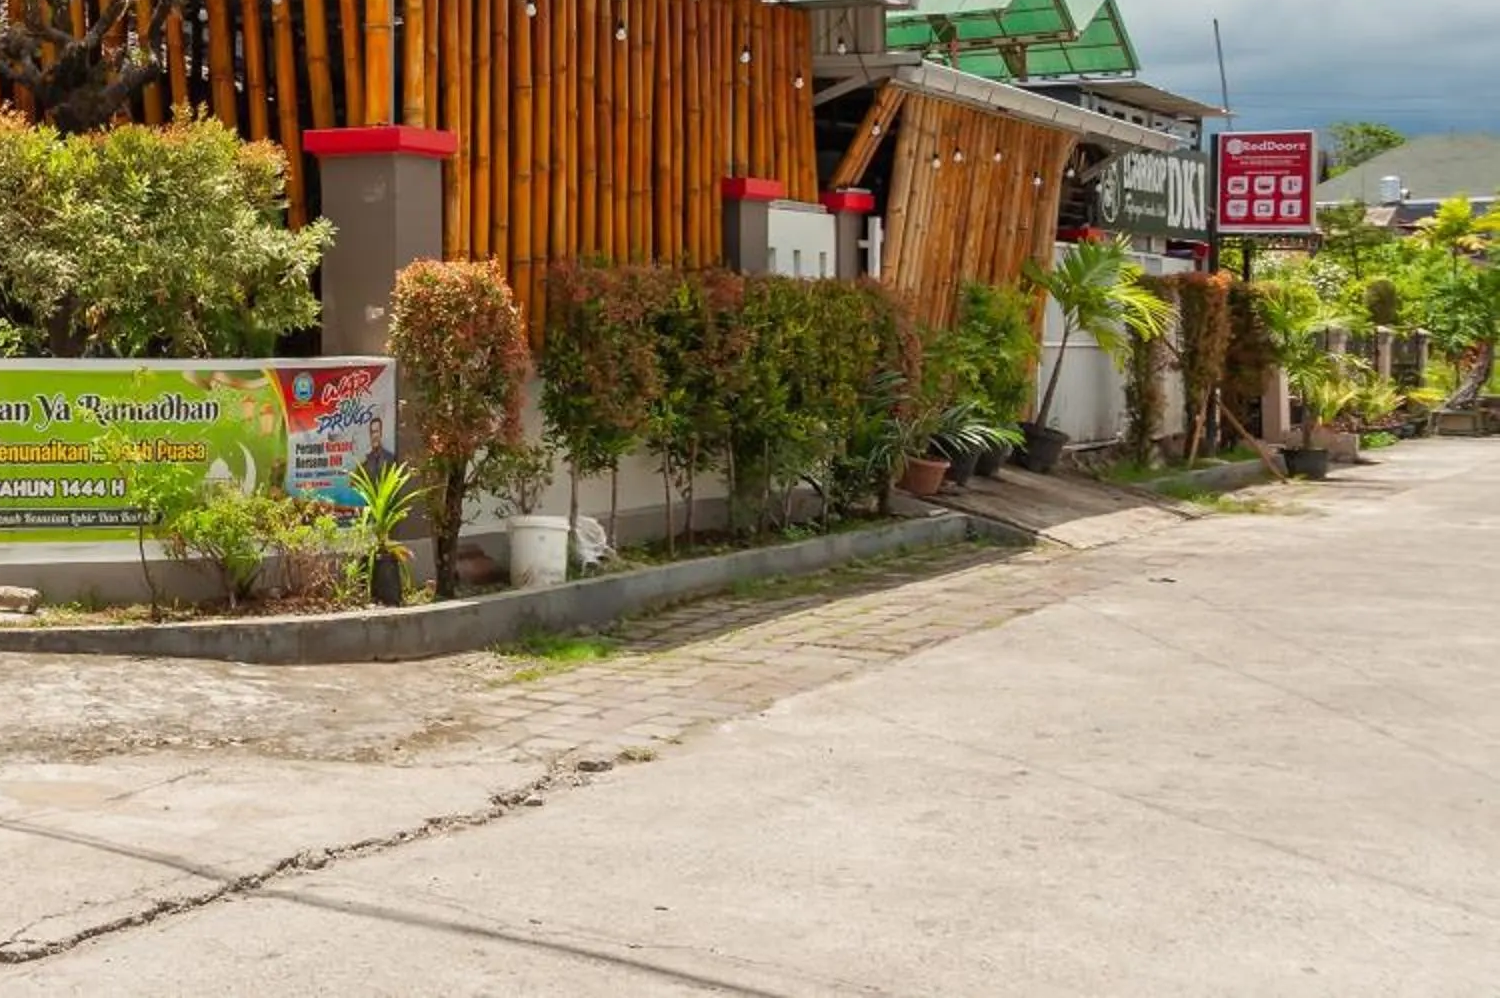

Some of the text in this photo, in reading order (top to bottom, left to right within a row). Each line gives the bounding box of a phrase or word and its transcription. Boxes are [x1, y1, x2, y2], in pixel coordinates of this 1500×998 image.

[1243, 139, 1306, 151] RedDoorz
[1167, 156, 1206, 230] DKI
[322, 369, 372, 406] WAR
[34, 393, 72, 432] Ya
[77, 392, 220, 427] Ramadhan
[316, 403, 377, 434] DRUGS
[155, 439, 206, 463] Puasa
[60, 478, 106, 497] 1444
[110, 478, 126, 497] H
